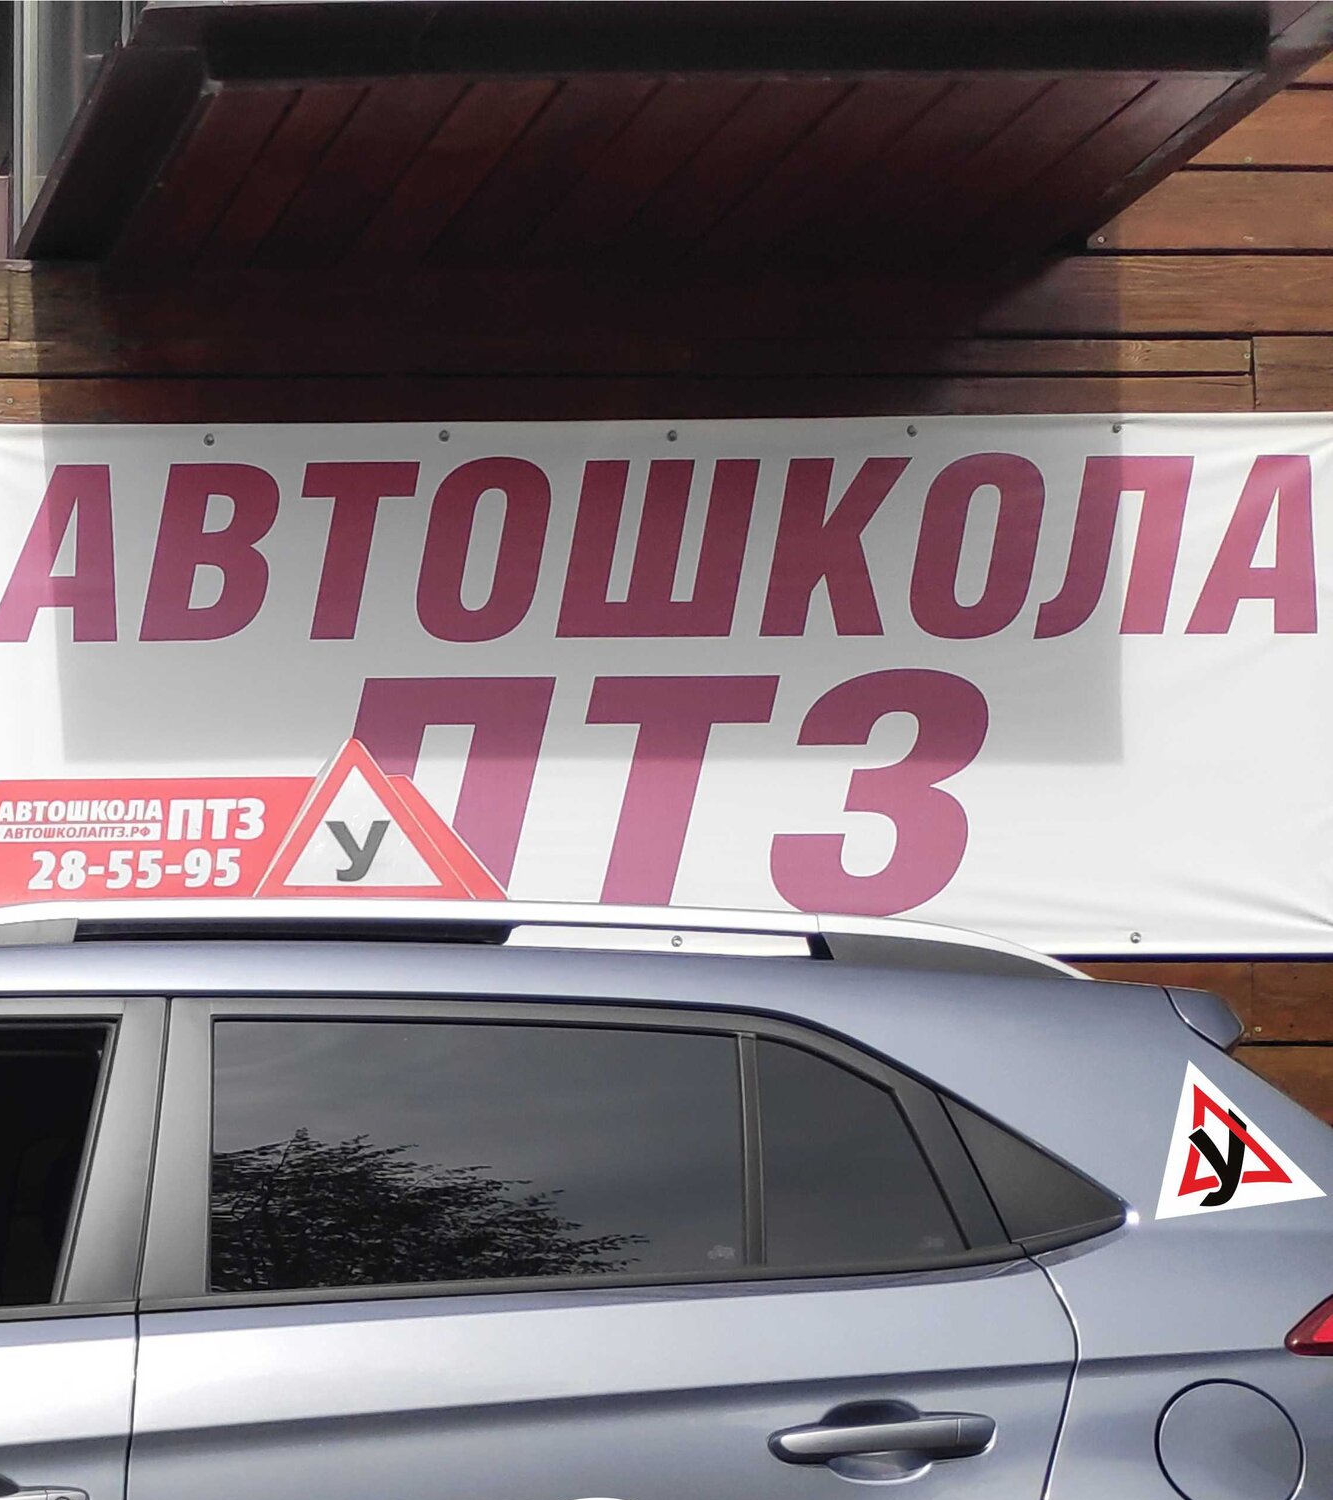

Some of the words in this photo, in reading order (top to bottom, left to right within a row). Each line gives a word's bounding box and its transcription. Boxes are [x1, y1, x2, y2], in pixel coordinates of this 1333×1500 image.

[344, 668, 990, 918] ПТЗ
[3, 827, 151, 840] АВТОШКОЛАПТЗ.РФ
[166, 798, 266, 841] ПТЗ
[28, 848, 241, 890] 28-55-95
[326, 820, 390, 881] У
